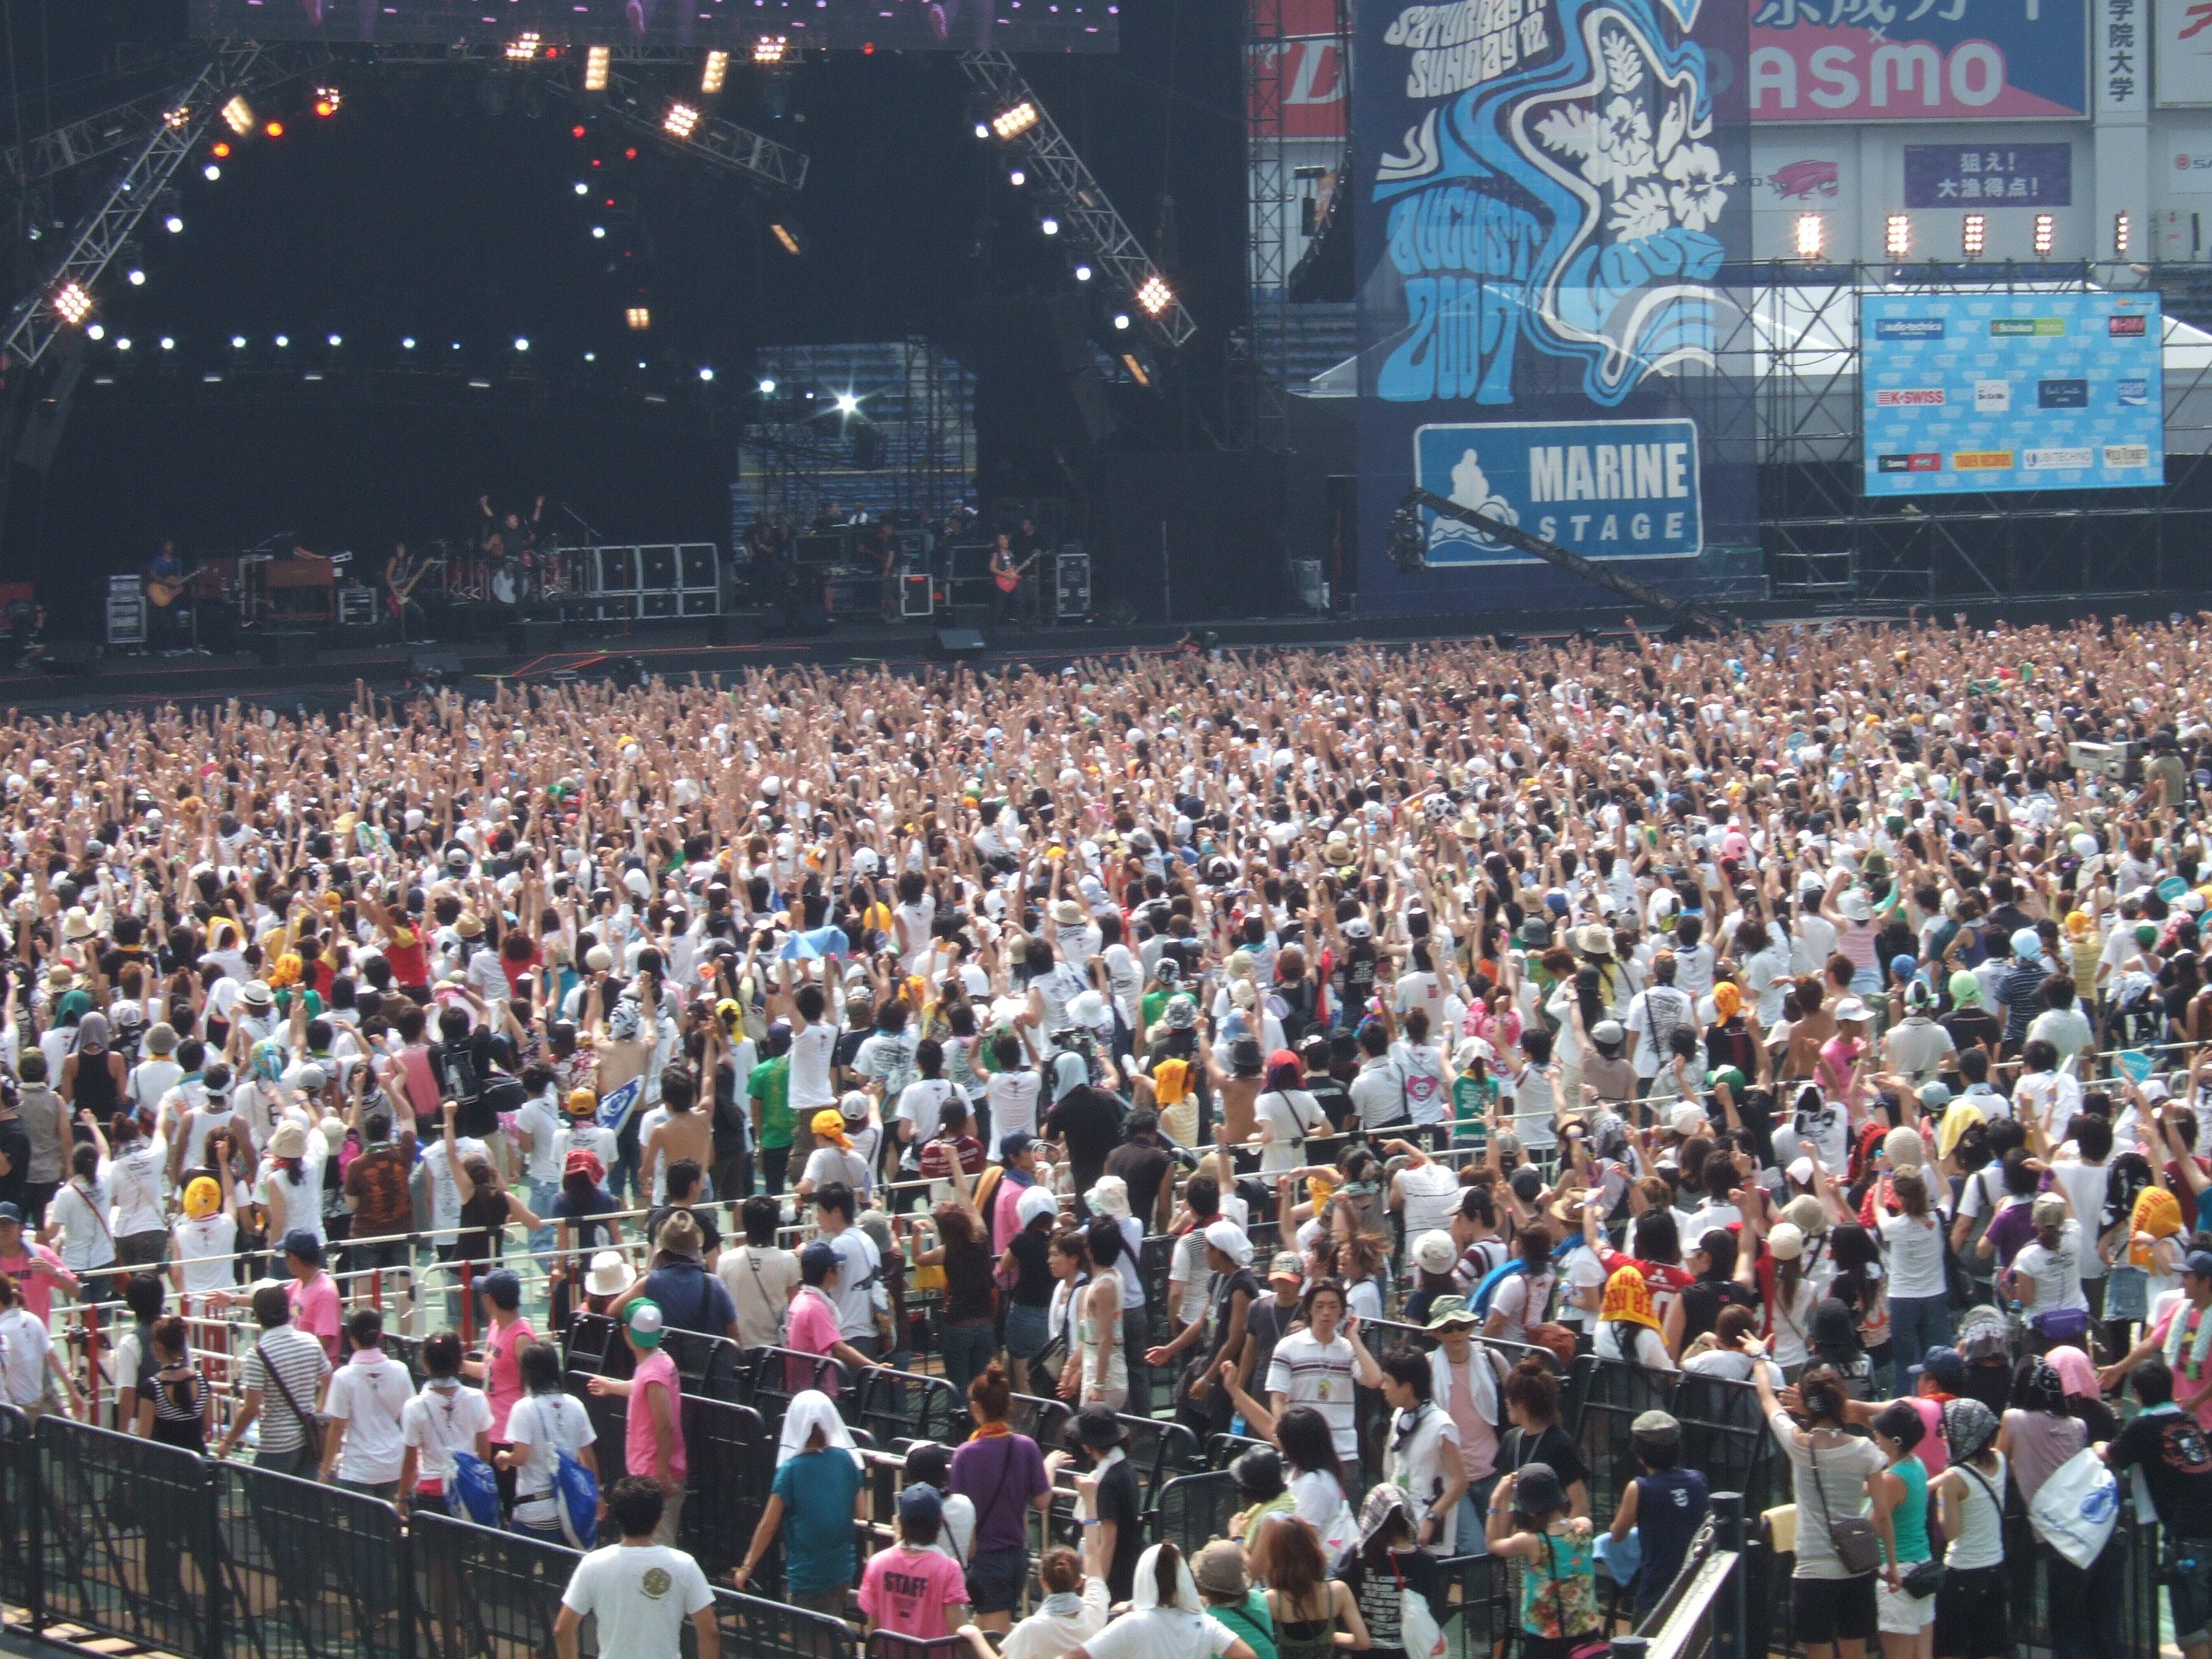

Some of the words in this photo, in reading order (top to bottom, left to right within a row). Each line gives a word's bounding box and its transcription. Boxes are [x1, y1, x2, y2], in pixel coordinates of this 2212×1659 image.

[1406, 26, 1518, 99] SUNDAY
[1520, 12, 1549, 57] 12
[1386, 186, 1545, 280] AUGUST
[1378, 277, 1529, 405] 2007
[1529, 443, 1689, 503] MARINE
[1538, 511, 1685, 543] STAGE
[884, 1571, 927, 1598] STAFF
